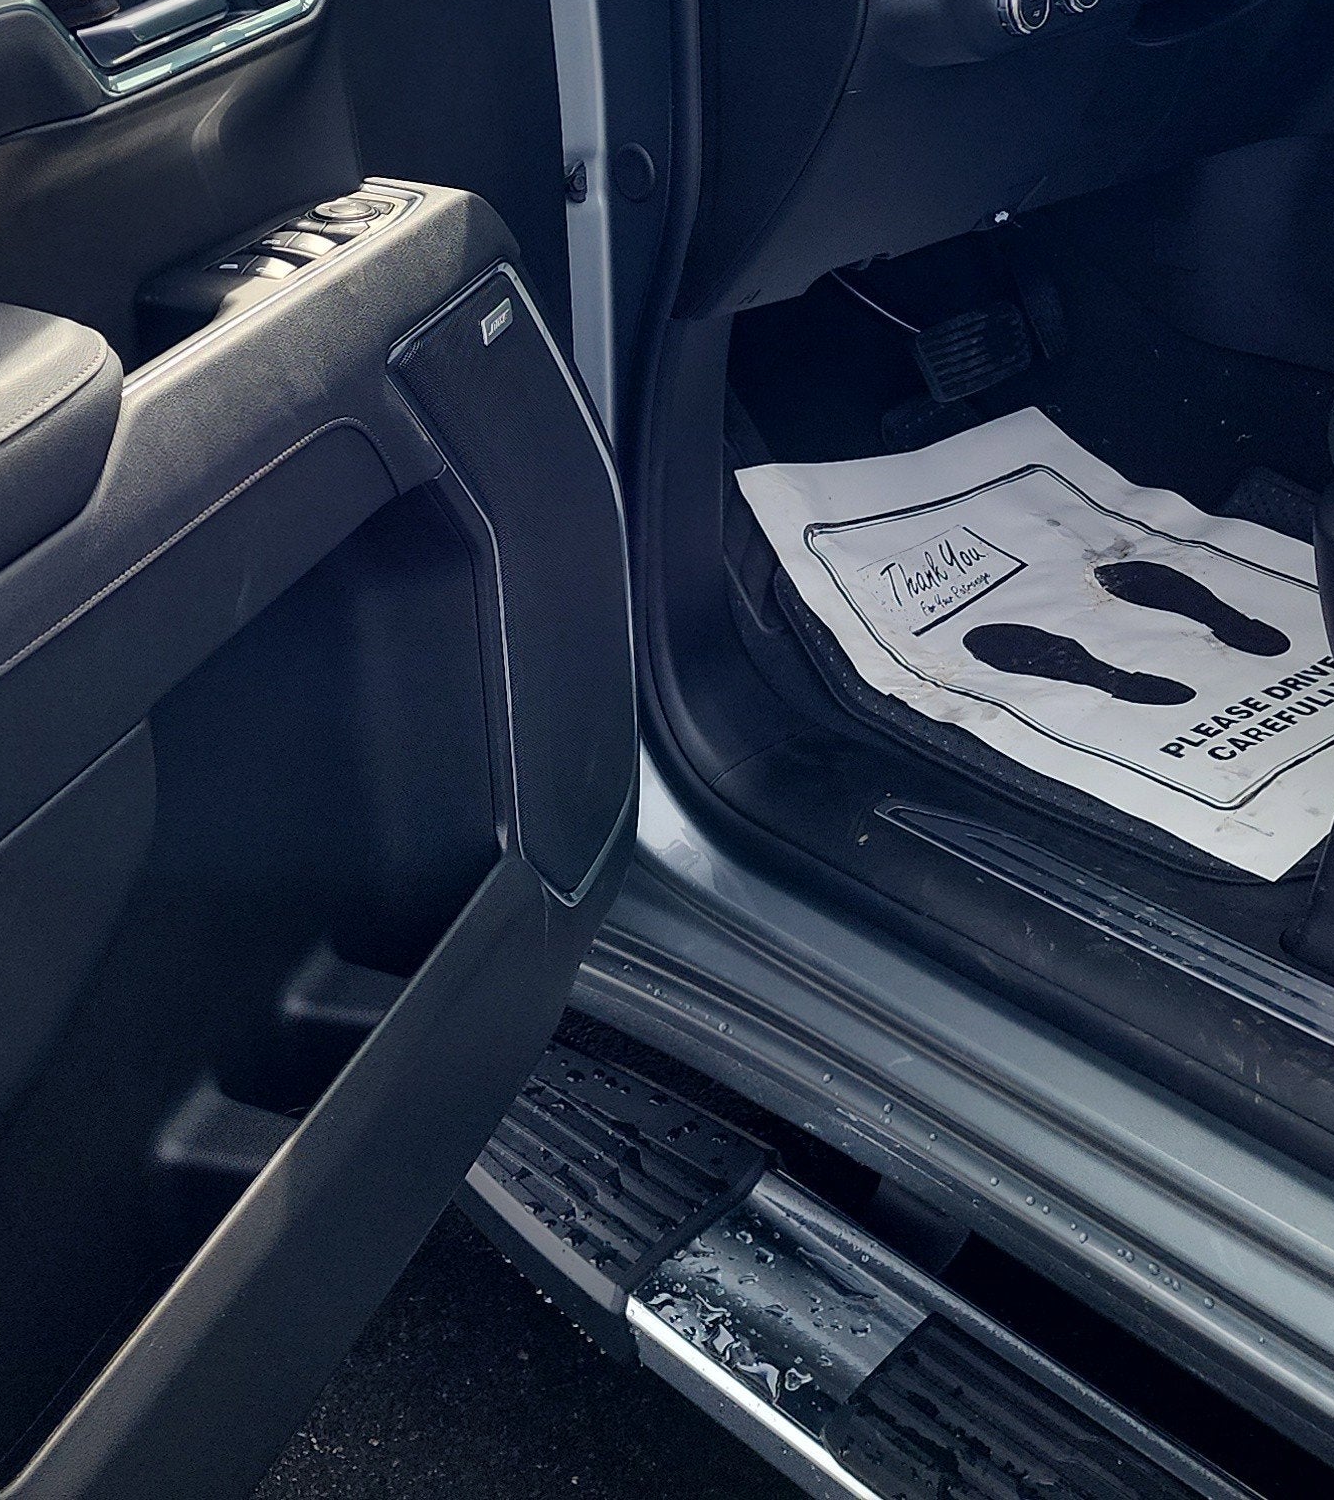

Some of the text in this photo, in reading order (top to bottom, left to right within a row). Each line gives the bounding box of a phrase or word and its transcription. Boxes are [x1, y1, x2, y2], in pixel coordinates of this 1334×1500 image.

[880, 539, 986, 606] Thank You
[1159, 696, 1272, 759] PLEASE
